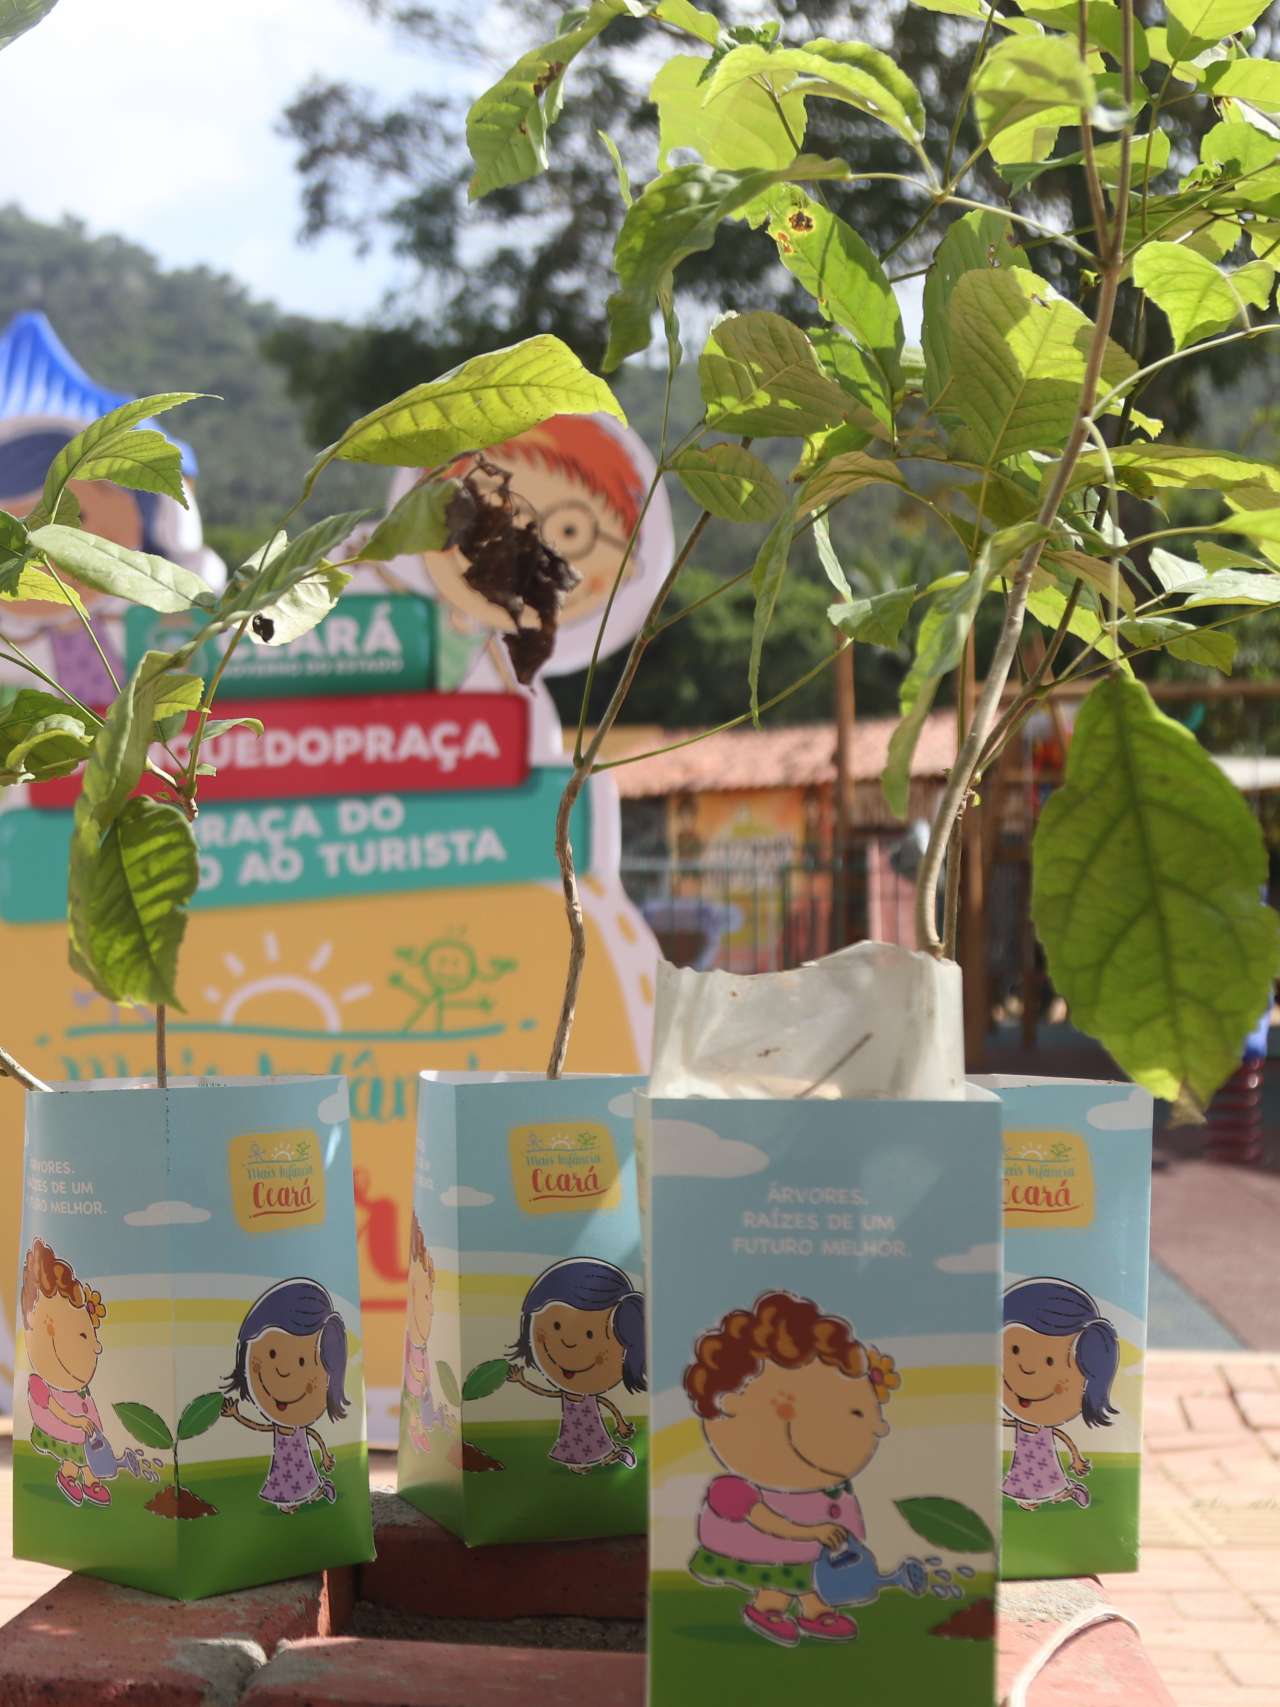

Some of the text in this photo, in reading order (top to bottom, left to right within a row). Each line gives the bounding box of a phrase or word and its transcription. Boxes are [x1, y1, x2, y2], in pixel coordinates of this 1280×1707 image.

[216, 602, 402, 657] CARÁ
[147, 722, 500, 772] QUEDOPRAÇA
[193, 796, 405, 851] RAÇA DO
[238, 850, 304, 886] AO
[319, 828, 506, 877] TURISTA
[71, 1182, 95, 1195] UM
[253, 1177, 312, 1209] Ceará
[531, 1165, 600, 1193] Ceará
[50, 1201, 108, 1215] MELHOR.
[743, 1208, 896, 1231] RAÍZES DE UM
[733, 1236, 814, 1256] FUTURO
